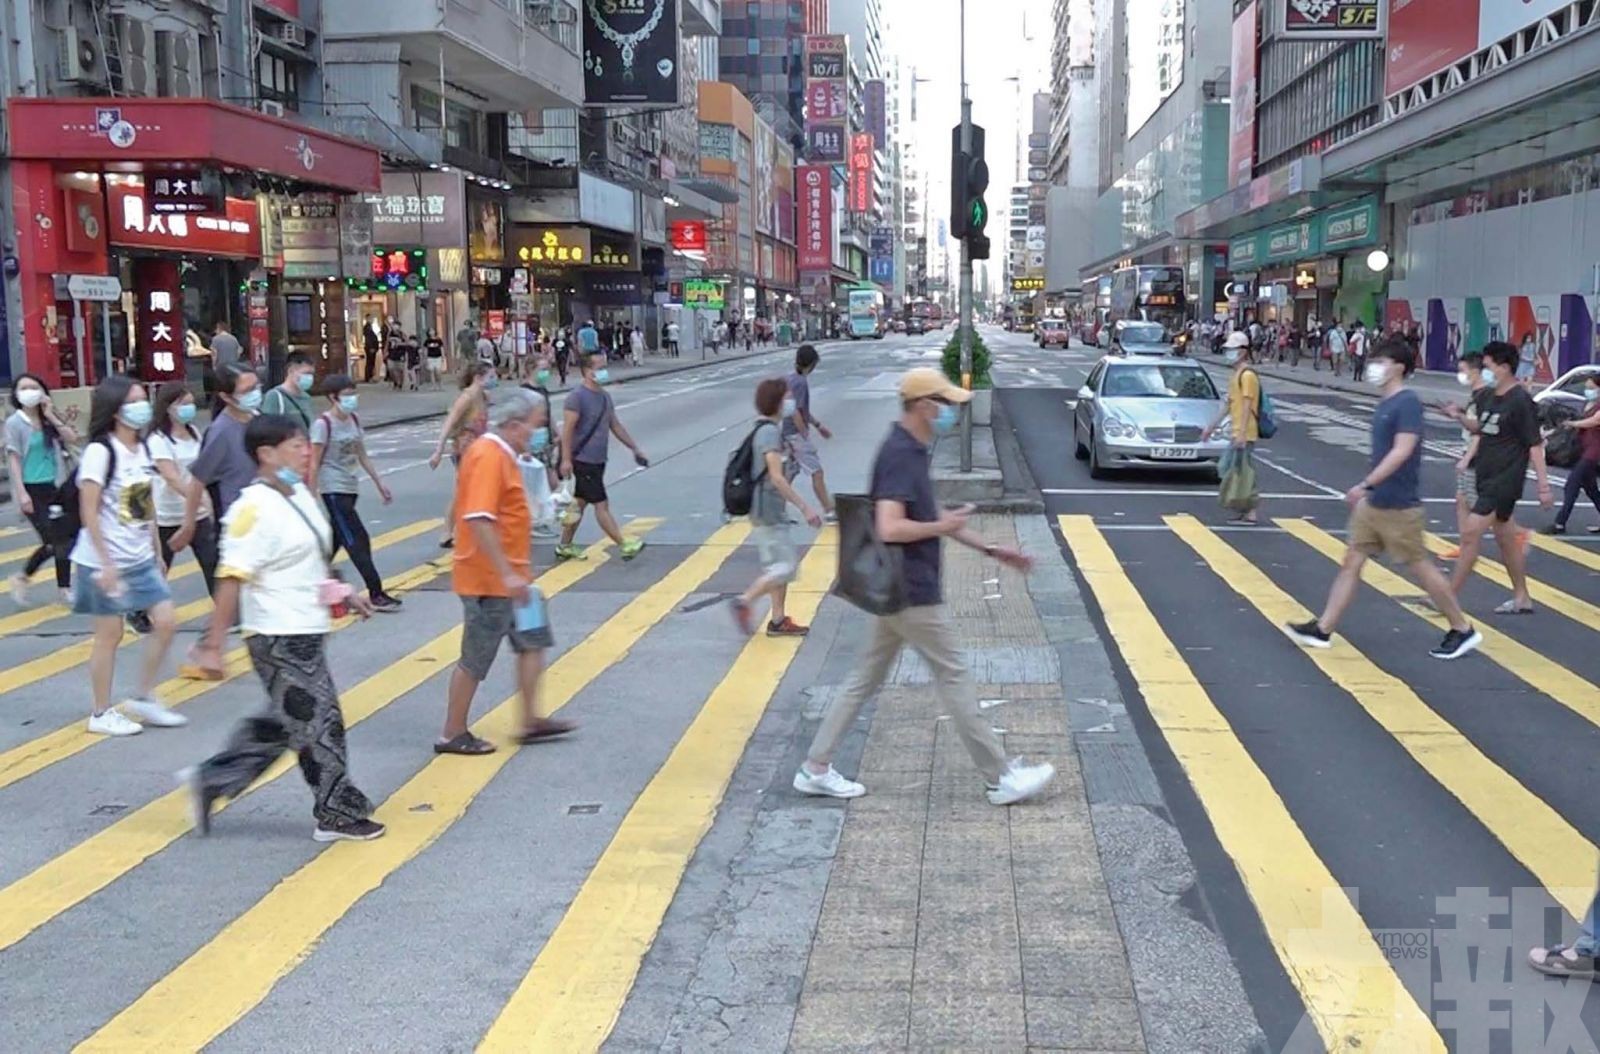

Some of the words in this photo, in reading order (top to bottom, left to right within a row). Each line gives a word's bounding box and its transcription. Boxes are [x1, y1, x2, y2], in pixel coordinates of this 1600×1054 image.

[813, 64, 840, 75] 10/F
[150, 291, 175, 371] 周大福
